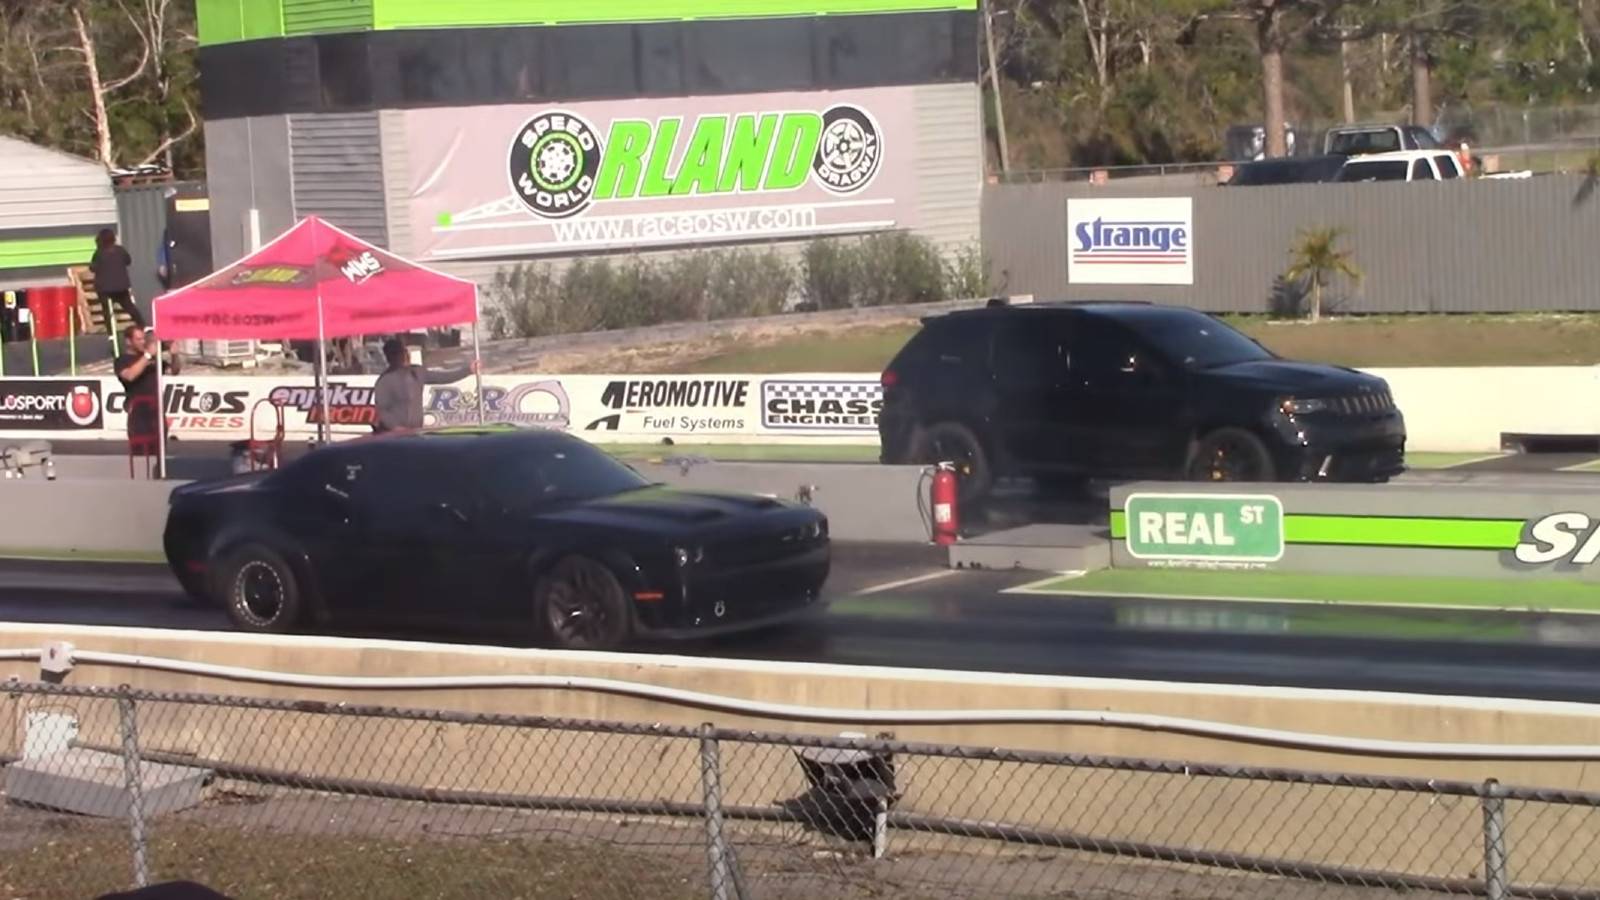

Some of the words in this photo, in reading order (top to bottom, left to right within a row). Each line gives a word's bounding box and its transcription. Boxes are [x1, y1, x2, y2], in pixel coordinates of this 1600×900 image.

[521, 115, 595, 151] SPEED
[818, 131, 876, 186] DRAGWAY
[518, 172, 593, 208] WORLD
[553, 206, 817, 242] www.raceosw.com
[1075, 216, 1187, 252] Strange
[106, 384, 249, 413] clitos
[601, 380, 749, 409] AEROMOTIVE
[643, 416, 675, 429] Fuel
[680, 415, 745, 431] Systems
[1138, 511, 1236, 545] REAL
[1239, 505, 1265, 524] ST
